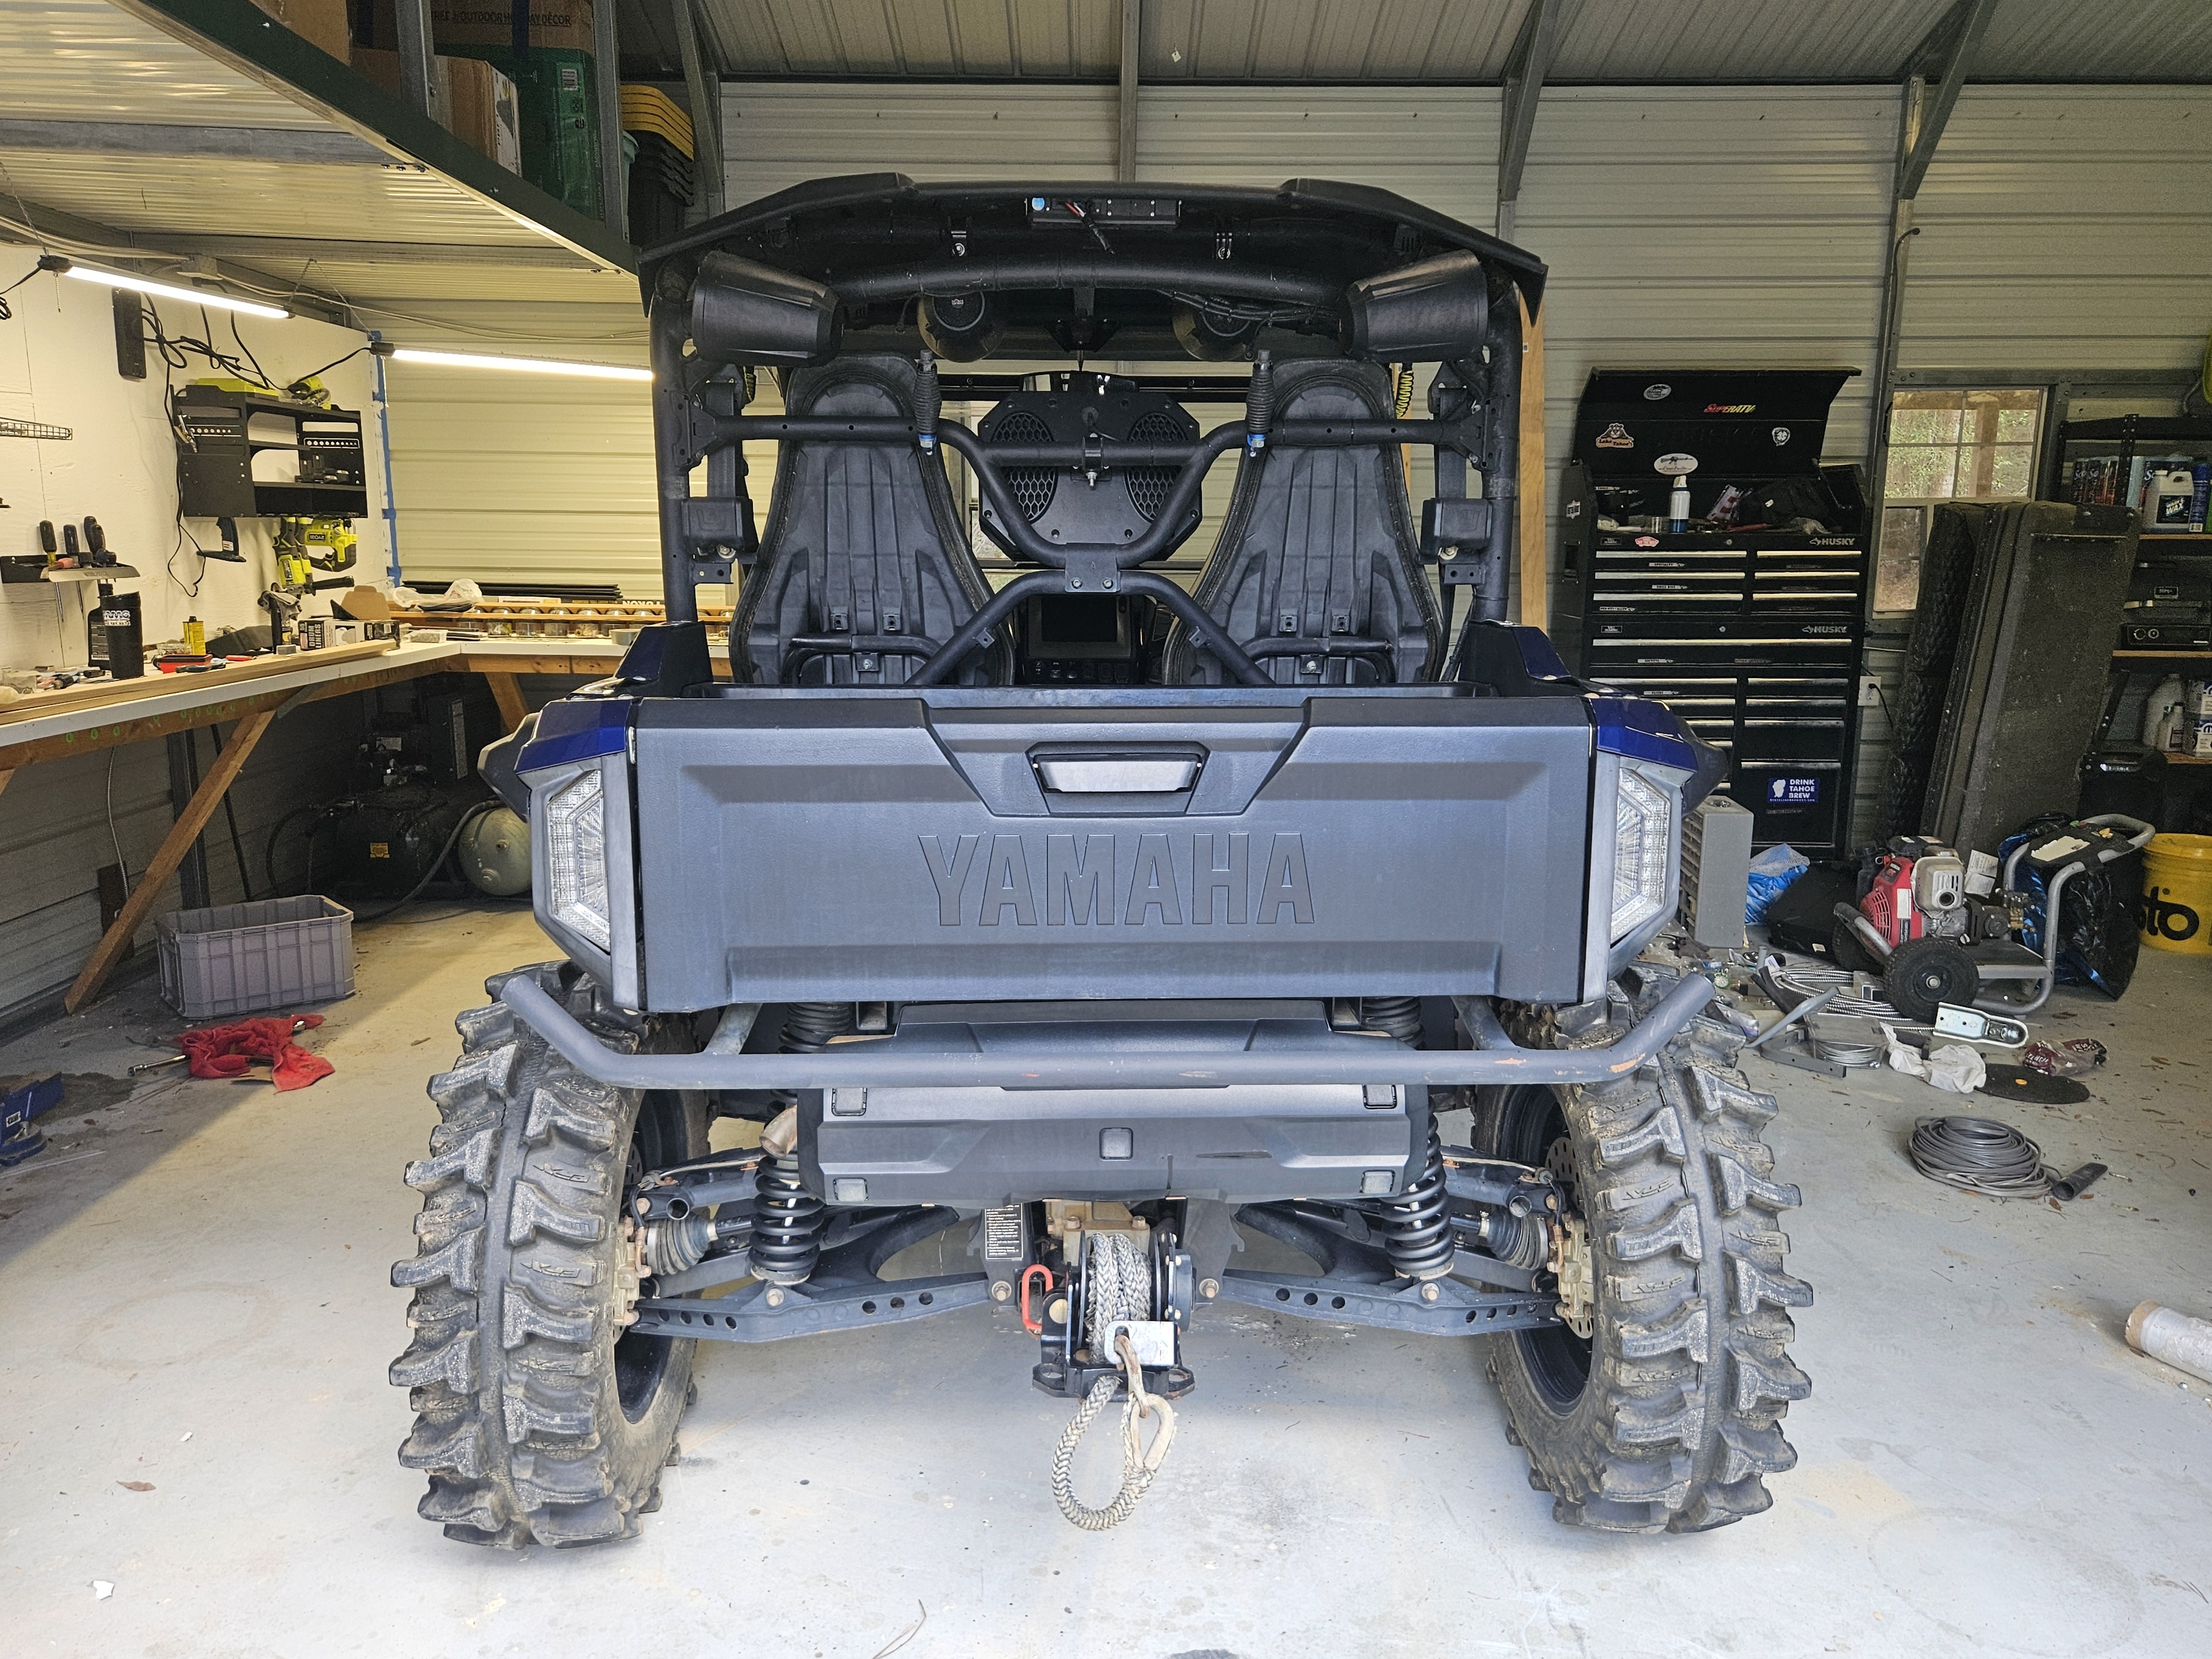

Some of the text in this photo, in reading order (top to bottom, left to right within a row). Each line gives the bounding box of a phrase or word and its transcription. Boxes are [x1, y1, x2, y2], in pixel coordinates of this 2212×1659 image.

[542, 13, 571, 25] DECOR
[2166, 502, 2184, 515] WAX
[917, 832, 1315, 926] YAMAHA
